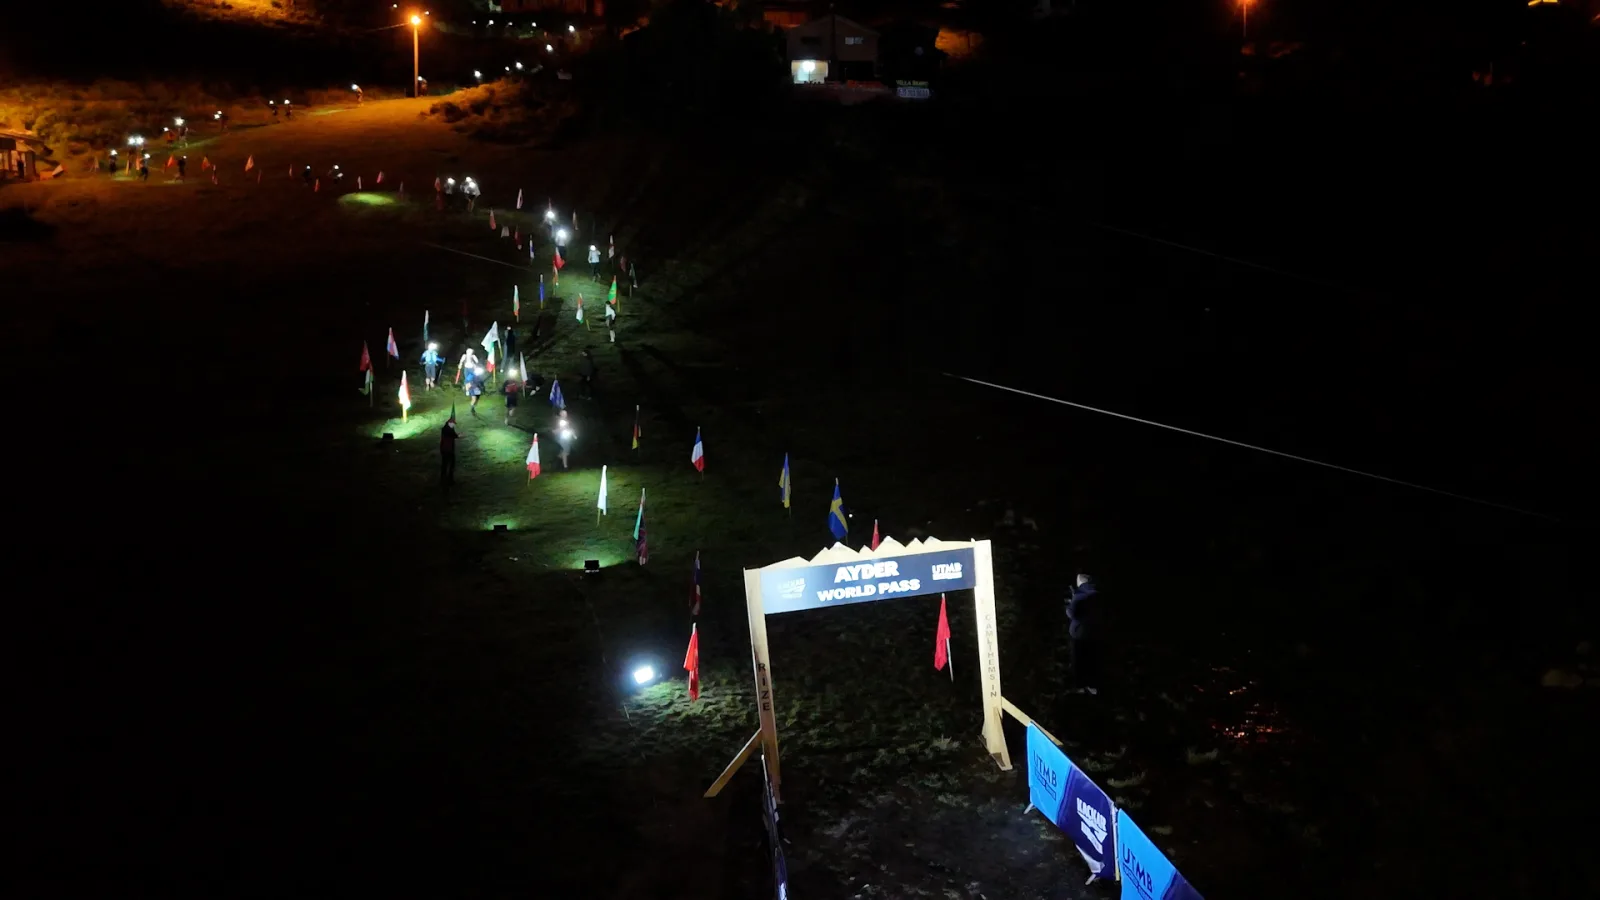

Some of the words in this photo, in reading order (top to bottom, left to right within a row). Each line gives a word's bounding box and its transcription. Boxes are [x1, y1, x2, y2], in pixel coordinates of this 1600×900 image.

[834, 560, 900, 584] AYDER
[931, 562, 962, 575] UTMB
[817, 584, 877, 602] WORLD
[878, 579, 921, 595] PASS
[1033, 750, 1058, 788] UTMB
[1122, 842, 1153, 894] UTMB
